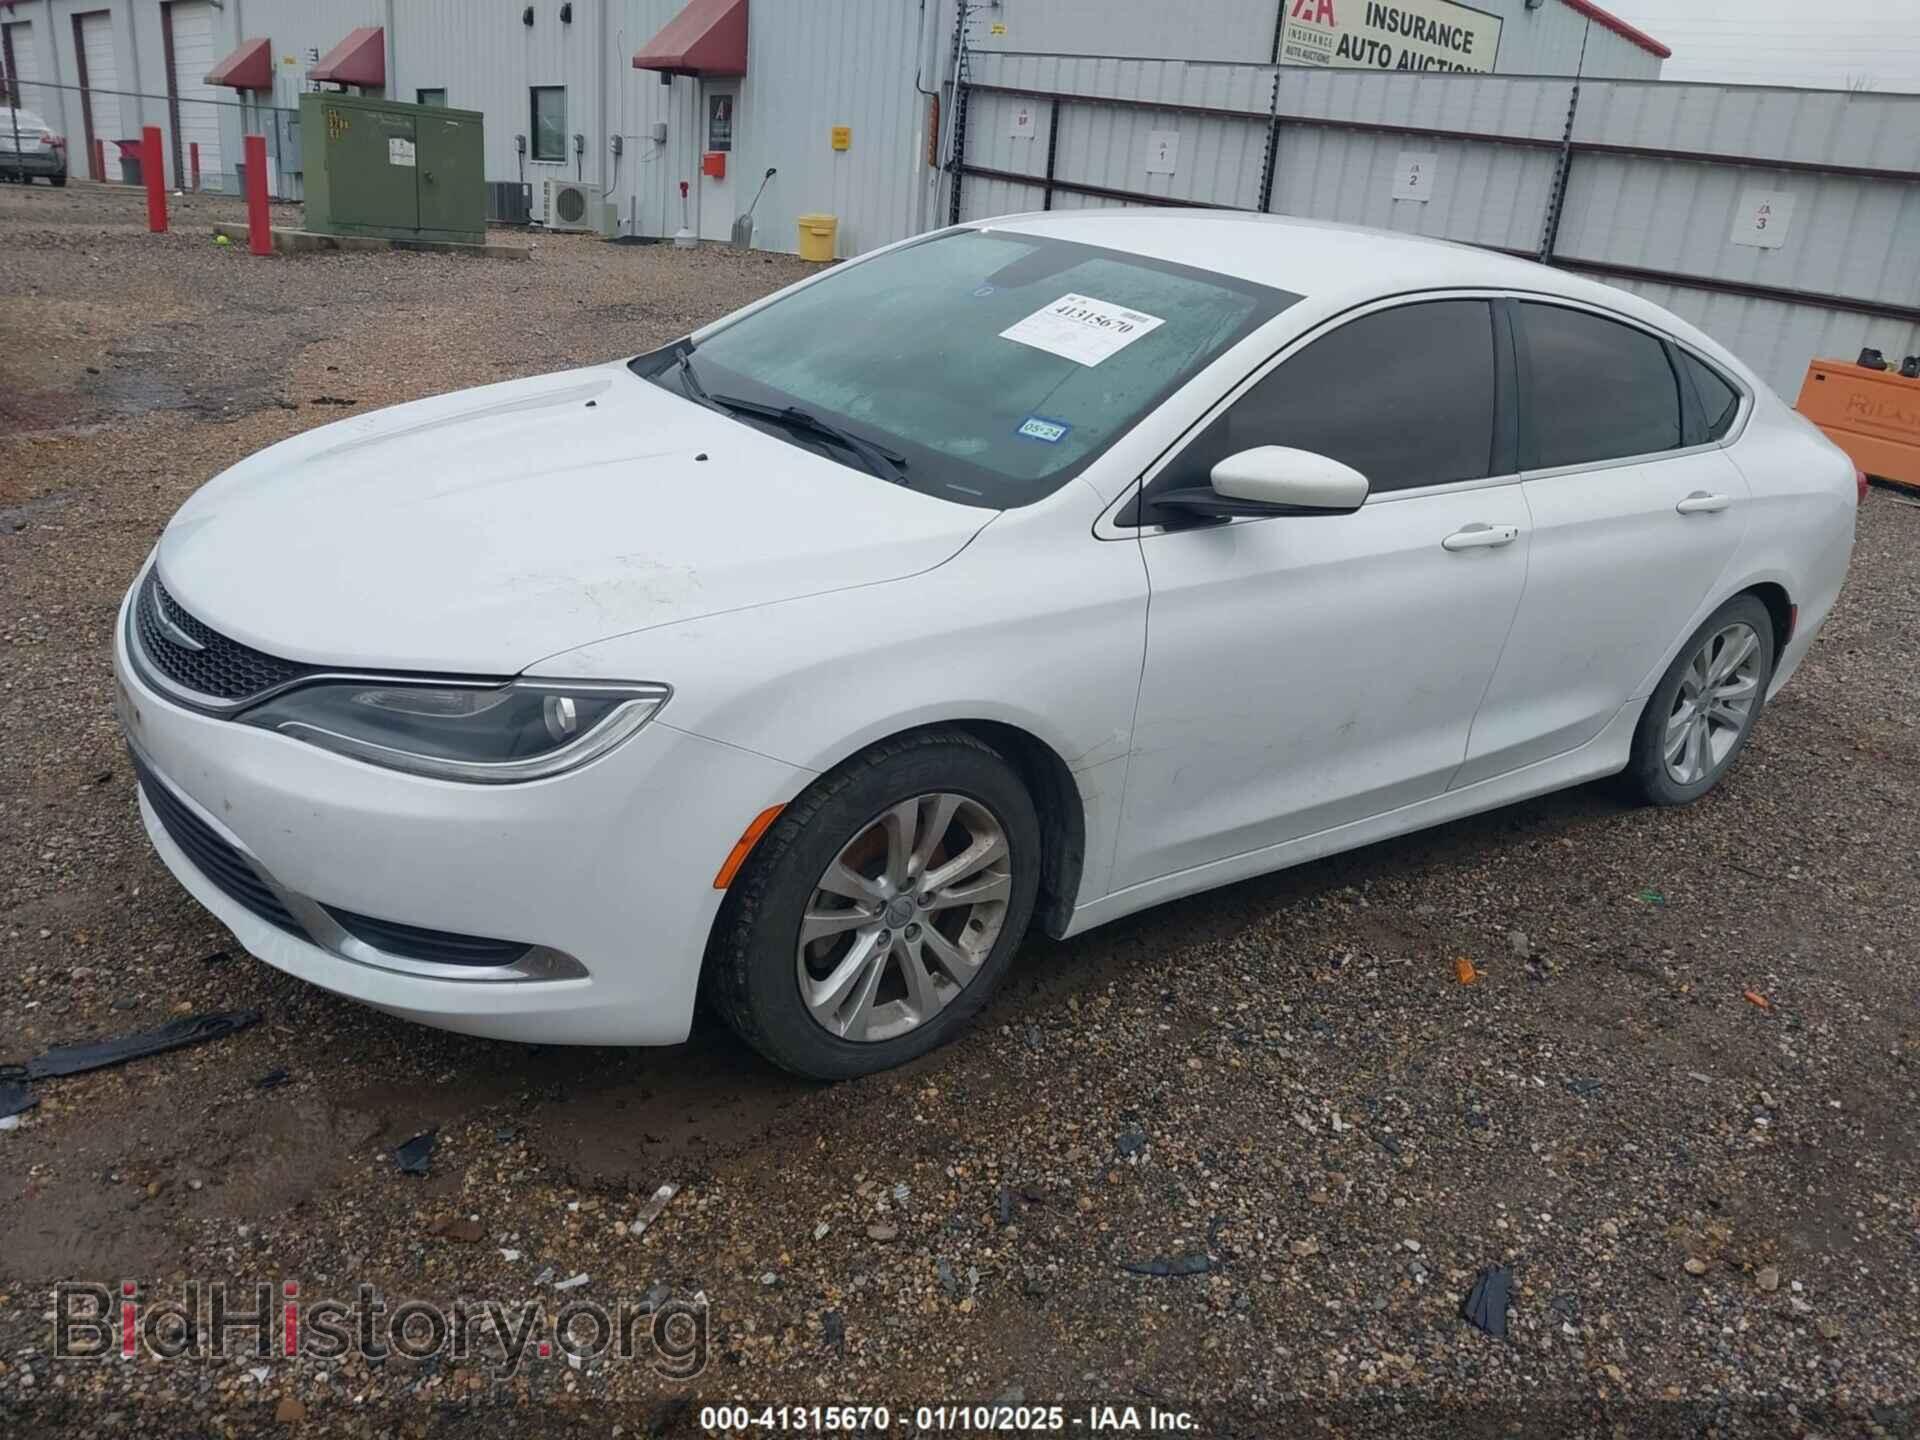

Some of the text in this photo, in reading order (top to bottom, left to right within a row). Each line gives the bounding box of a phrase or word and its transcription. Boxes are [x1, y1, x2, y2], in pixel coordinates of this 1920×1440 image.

[1287, 28, 1334, 48] INSURANCE
[1365, 1, 1474, 54] INSURANCE
[1336, 32, 1391, 68] AUTO
[1409, 175, 1418, 186] 2
[1756, 217, 1767, 230] 3
[1055, 305, 1134, 333] 41315670
